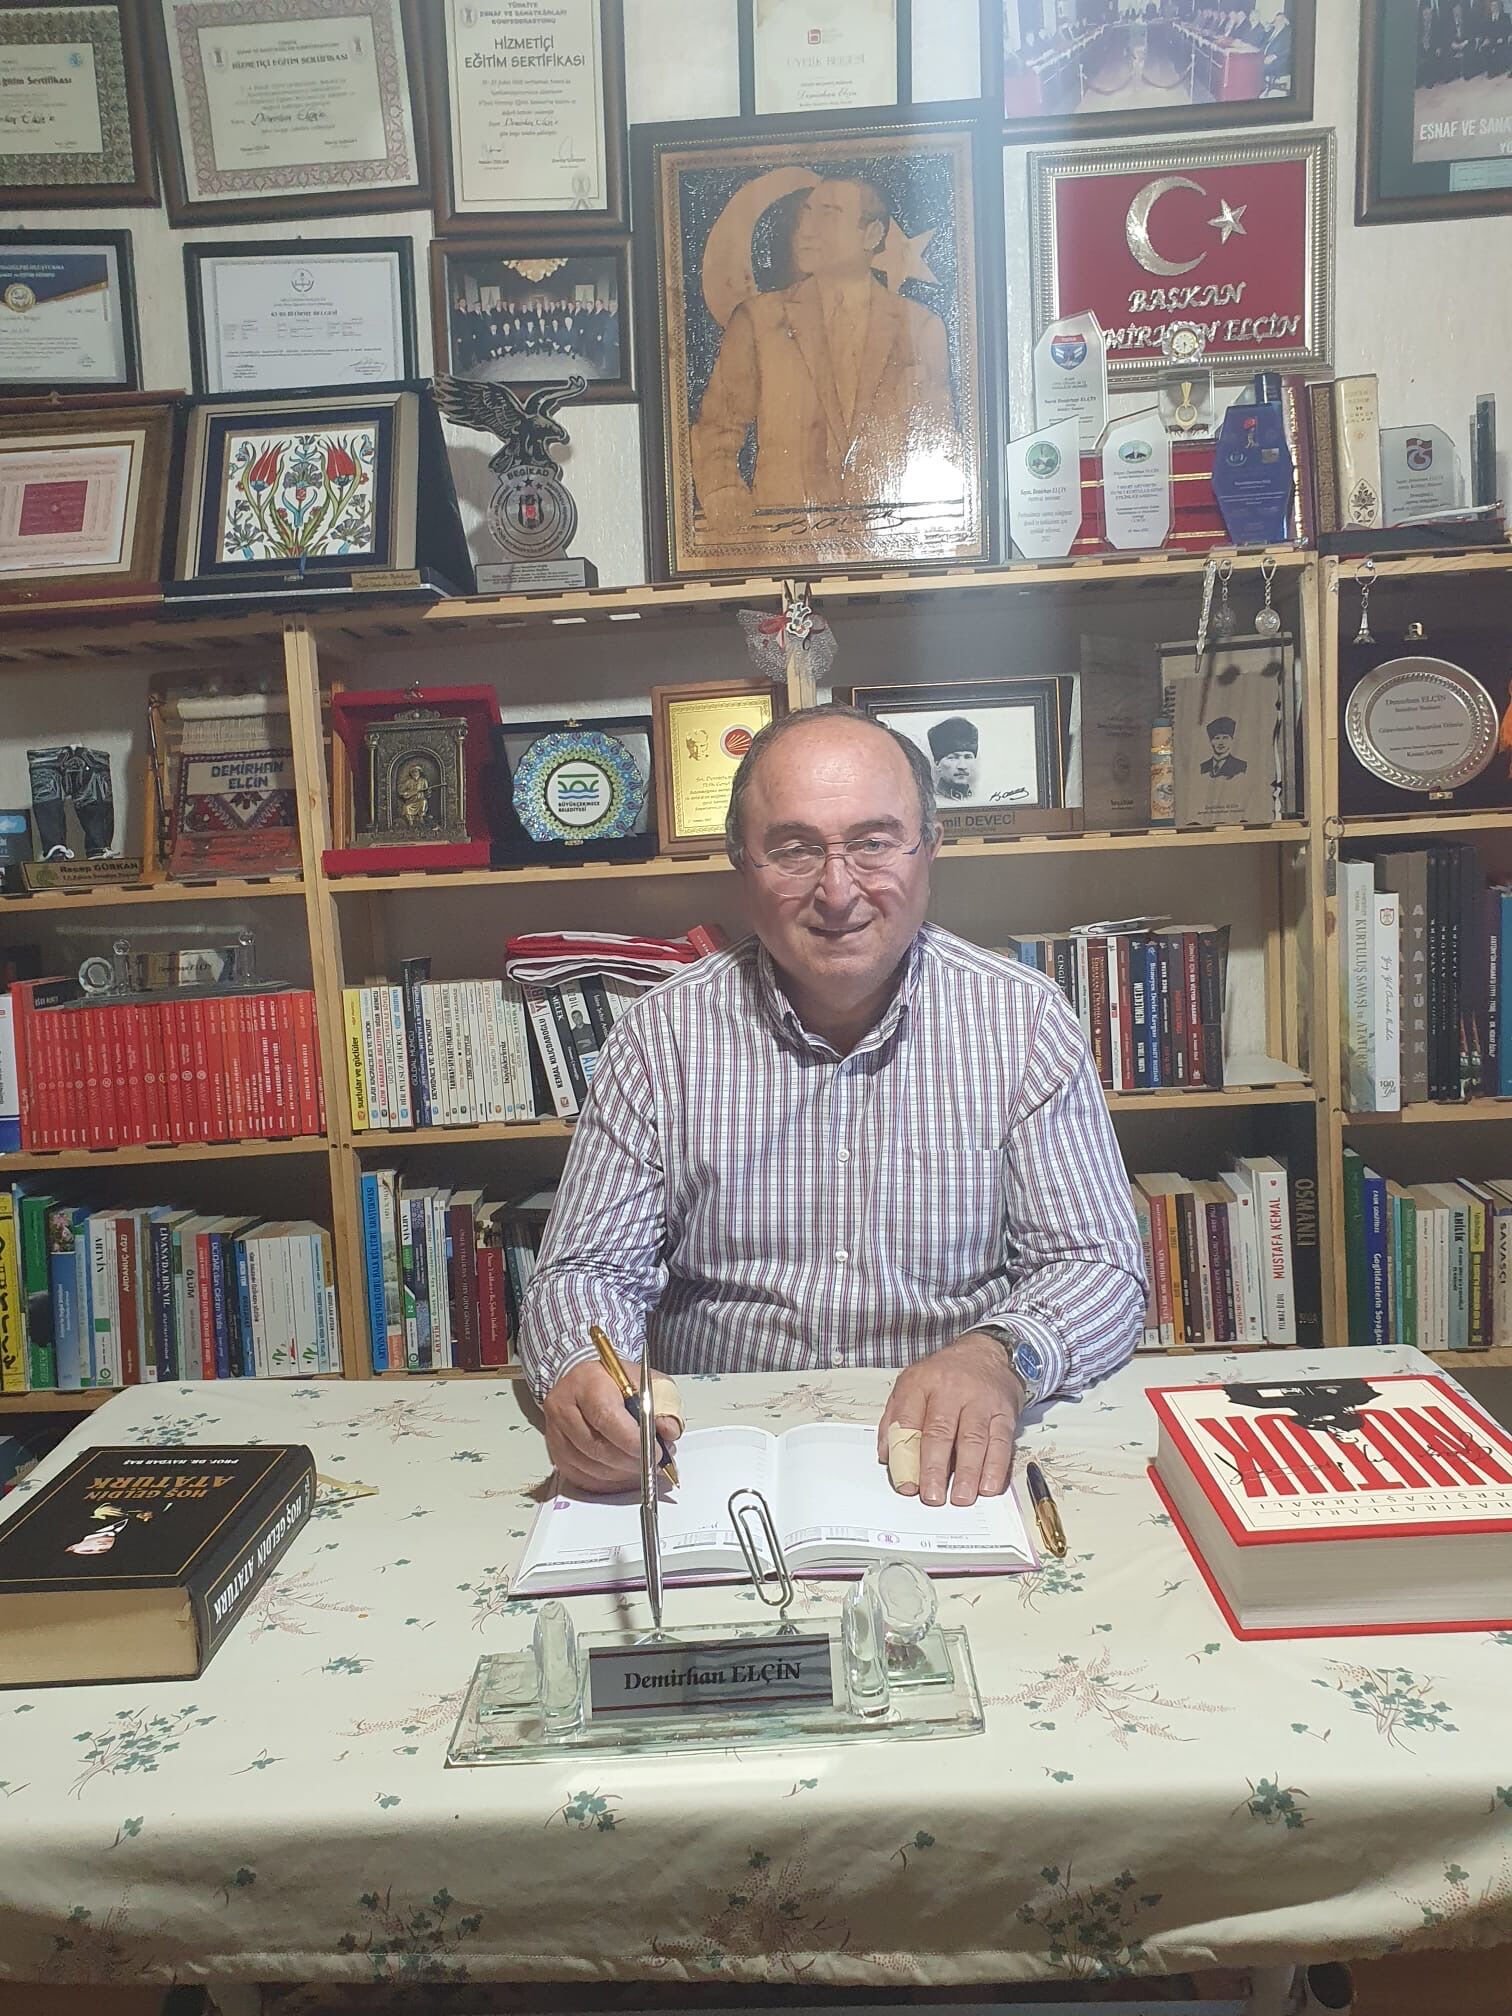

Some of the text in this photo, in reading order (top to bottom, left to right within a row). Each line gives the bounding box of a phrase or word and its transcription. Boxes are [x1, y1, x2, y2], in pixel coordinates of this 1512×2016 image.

[494, 35, 555, 52] HİZMETİÇİ
[464, 53, 586, 69] EĞİTİM SERTİFİKASI
[1419, 120, 1458, 142] ESNAF
[1461, 119, 1476, 137] VE
[1128, 281, 1248, 315] BAŞKAN
[1222, 311, 1303, 344] ELÇİN
[211, 760, 284, 778] DEMİRHAN
[964, 811, 1017, 827] DEVECİ
[1354, 918, 1369, 973] KURTULUŞ
[1353, 974, 1369, 1009] SAVAŞI
[350, 1036, 365, 1110] suçlular ve güçlüler
[553, 1066, 565, 1090] KEMAL
[1294, 1178, 1317, 1247] OSMANLI
[1269, 1198, 1286, 1280] MUSTAFA KEMAL
[120, 1233, 131, 1292] ARDANUÇ AĞZI
[186, 1268, 197, 1299] ÖLÜM
[84, 1489, 209, 1500] HOŞ GELDİN
[86, 1475, 237, 1491] ATATÜRK
[212, 1495, 303, 1625] HOŞ GELDİN ATATÜRK
[623, 1657, 802, 1691] Demirhan ELÇİN
